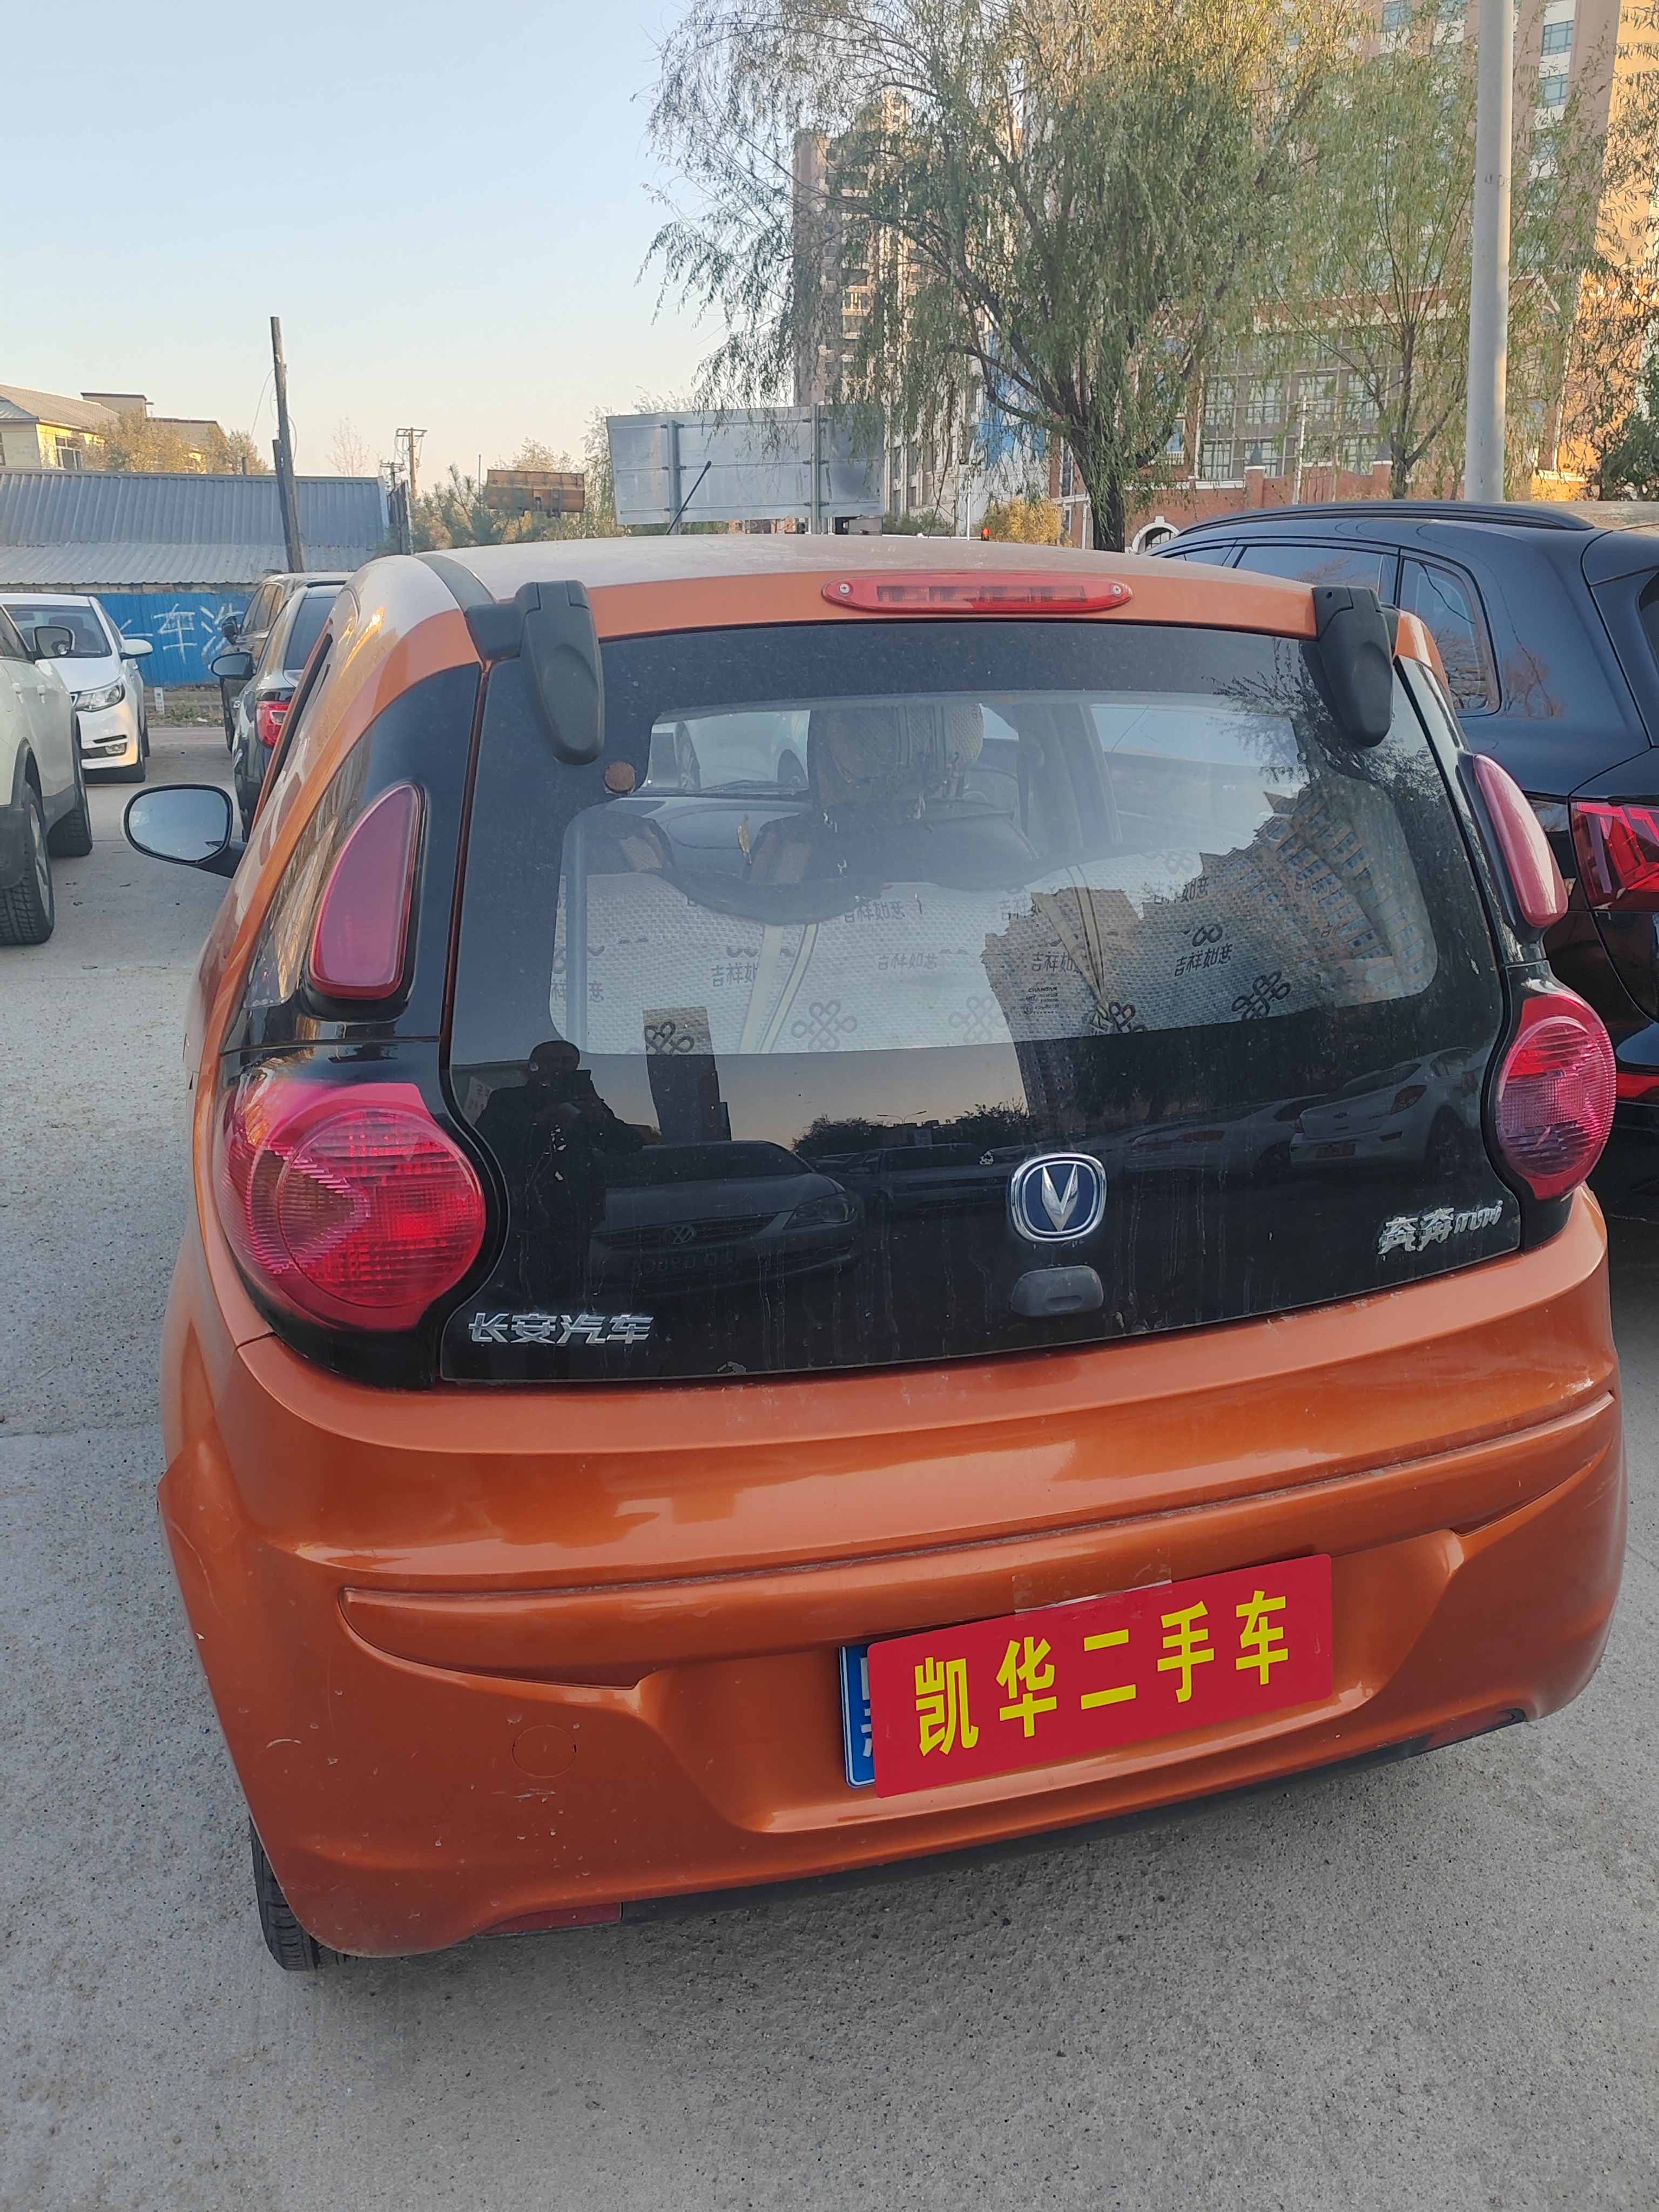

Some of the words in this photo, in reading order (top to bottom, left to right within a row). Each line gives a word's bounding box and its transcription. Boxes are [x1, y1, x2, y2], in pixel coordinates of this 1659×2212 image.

[1174, 942, 1233, 977] 吉祥如意
[468, 1312, 654, 1344] 长安汽车
[914, 1590, 1289, 1756] 凯华二手车
